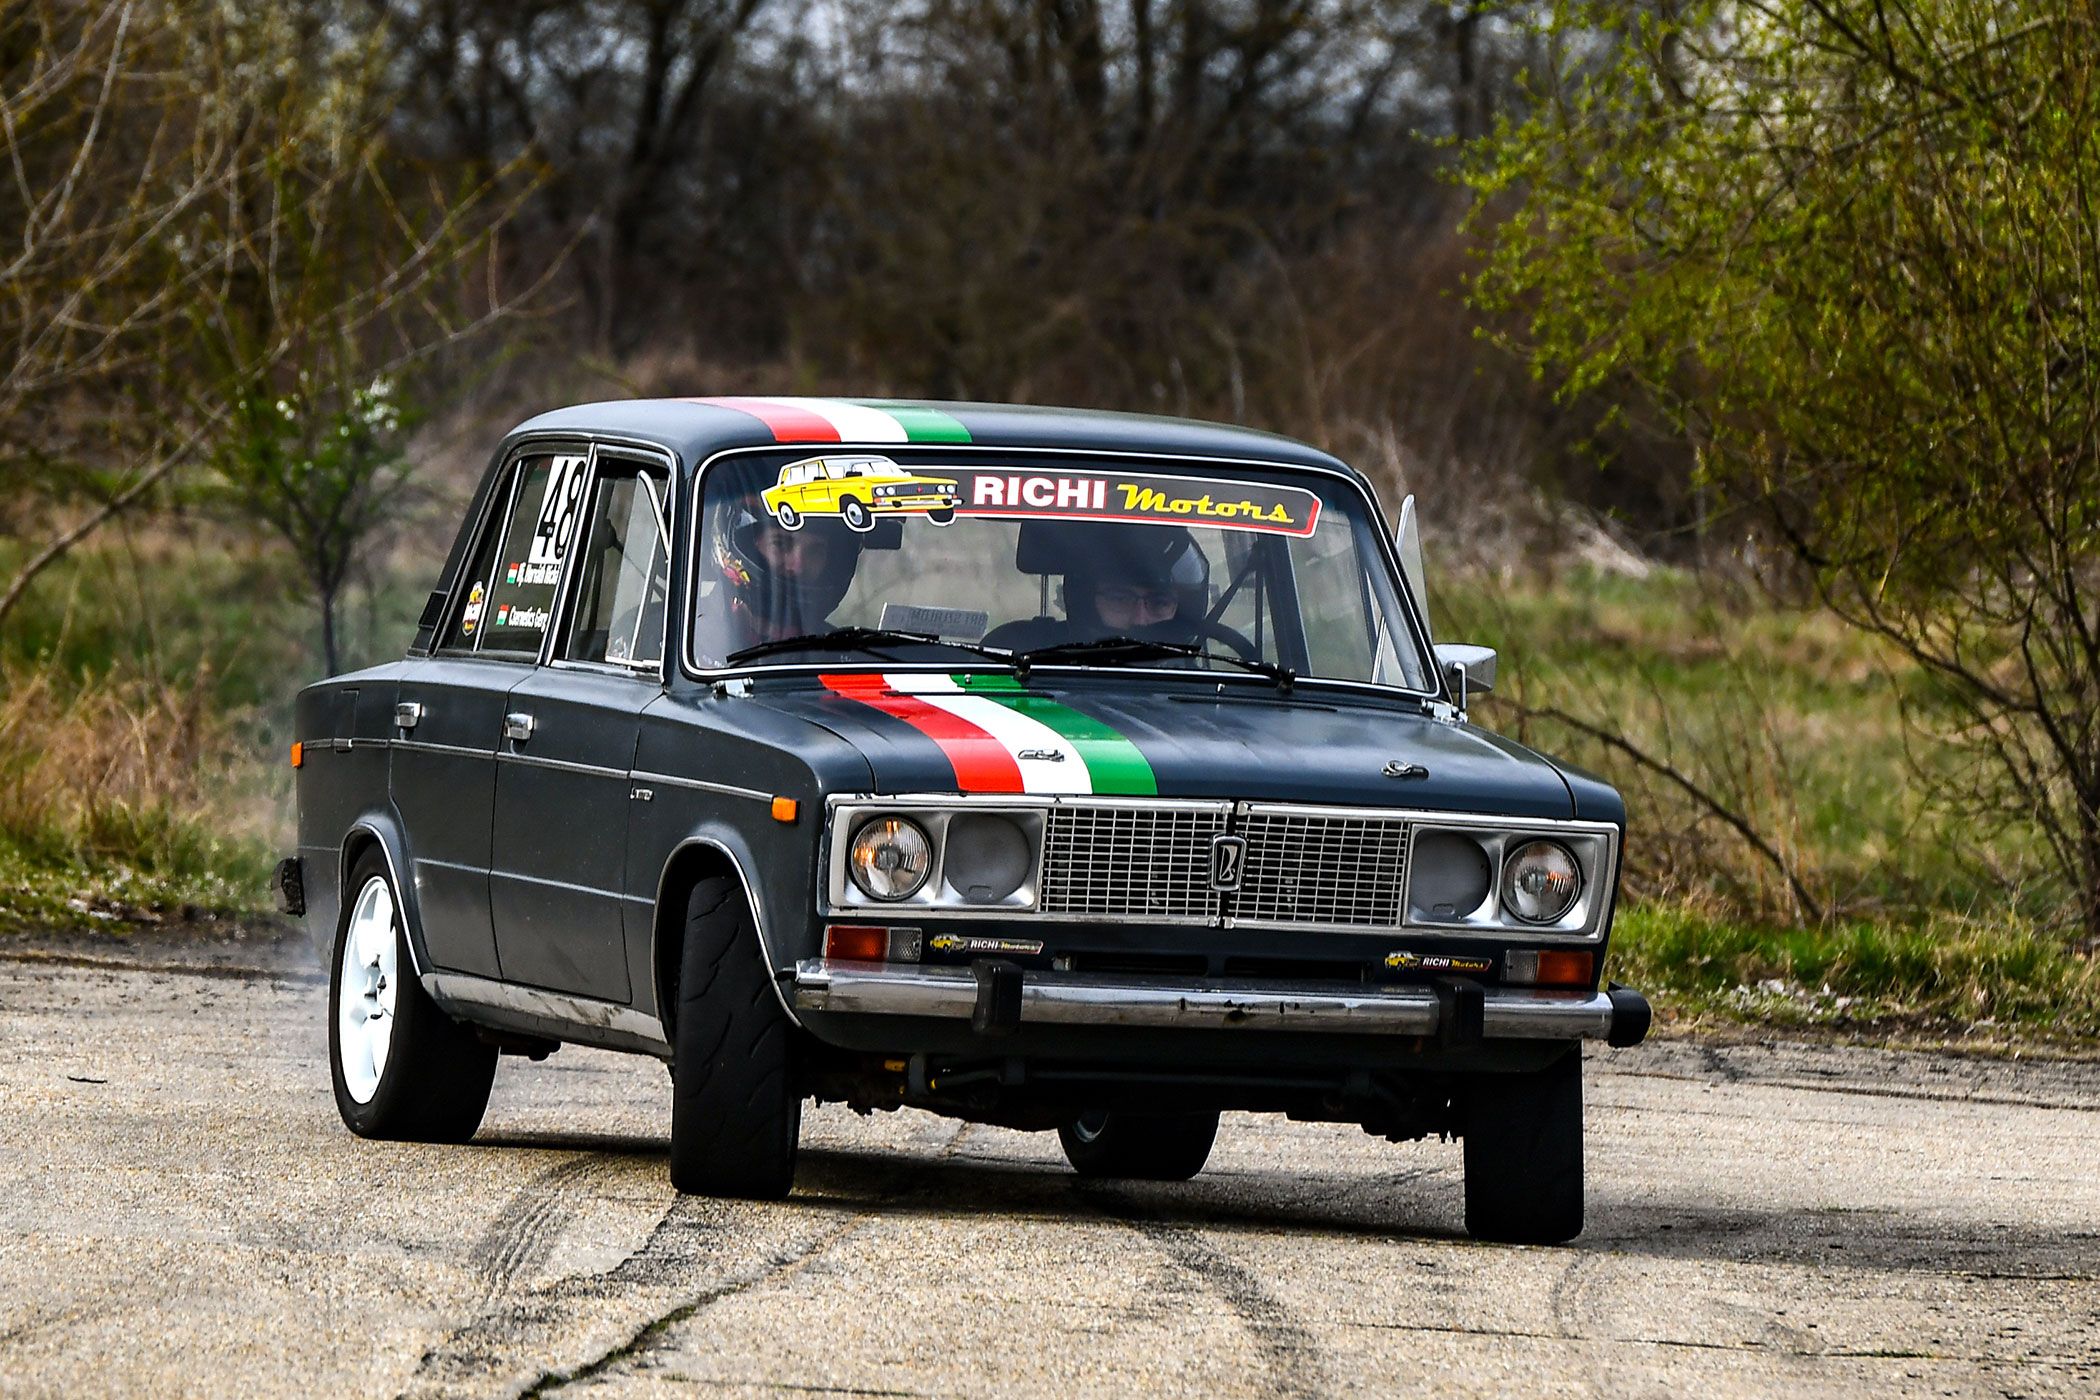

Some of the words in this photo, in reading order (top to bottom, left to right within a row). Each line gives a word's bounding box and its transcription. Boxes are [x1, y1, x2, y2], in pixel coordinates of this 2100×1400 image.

[537, 459, 587, 560] 48
[972, 475, 1108, 510] RICHI
[1117, 483, 1294, 524] Motors
[970, 940, 998, 949] RICHI
[1423, 957, 1450, 967] RICHI
[1451, 959, 1483, 968] Motors
